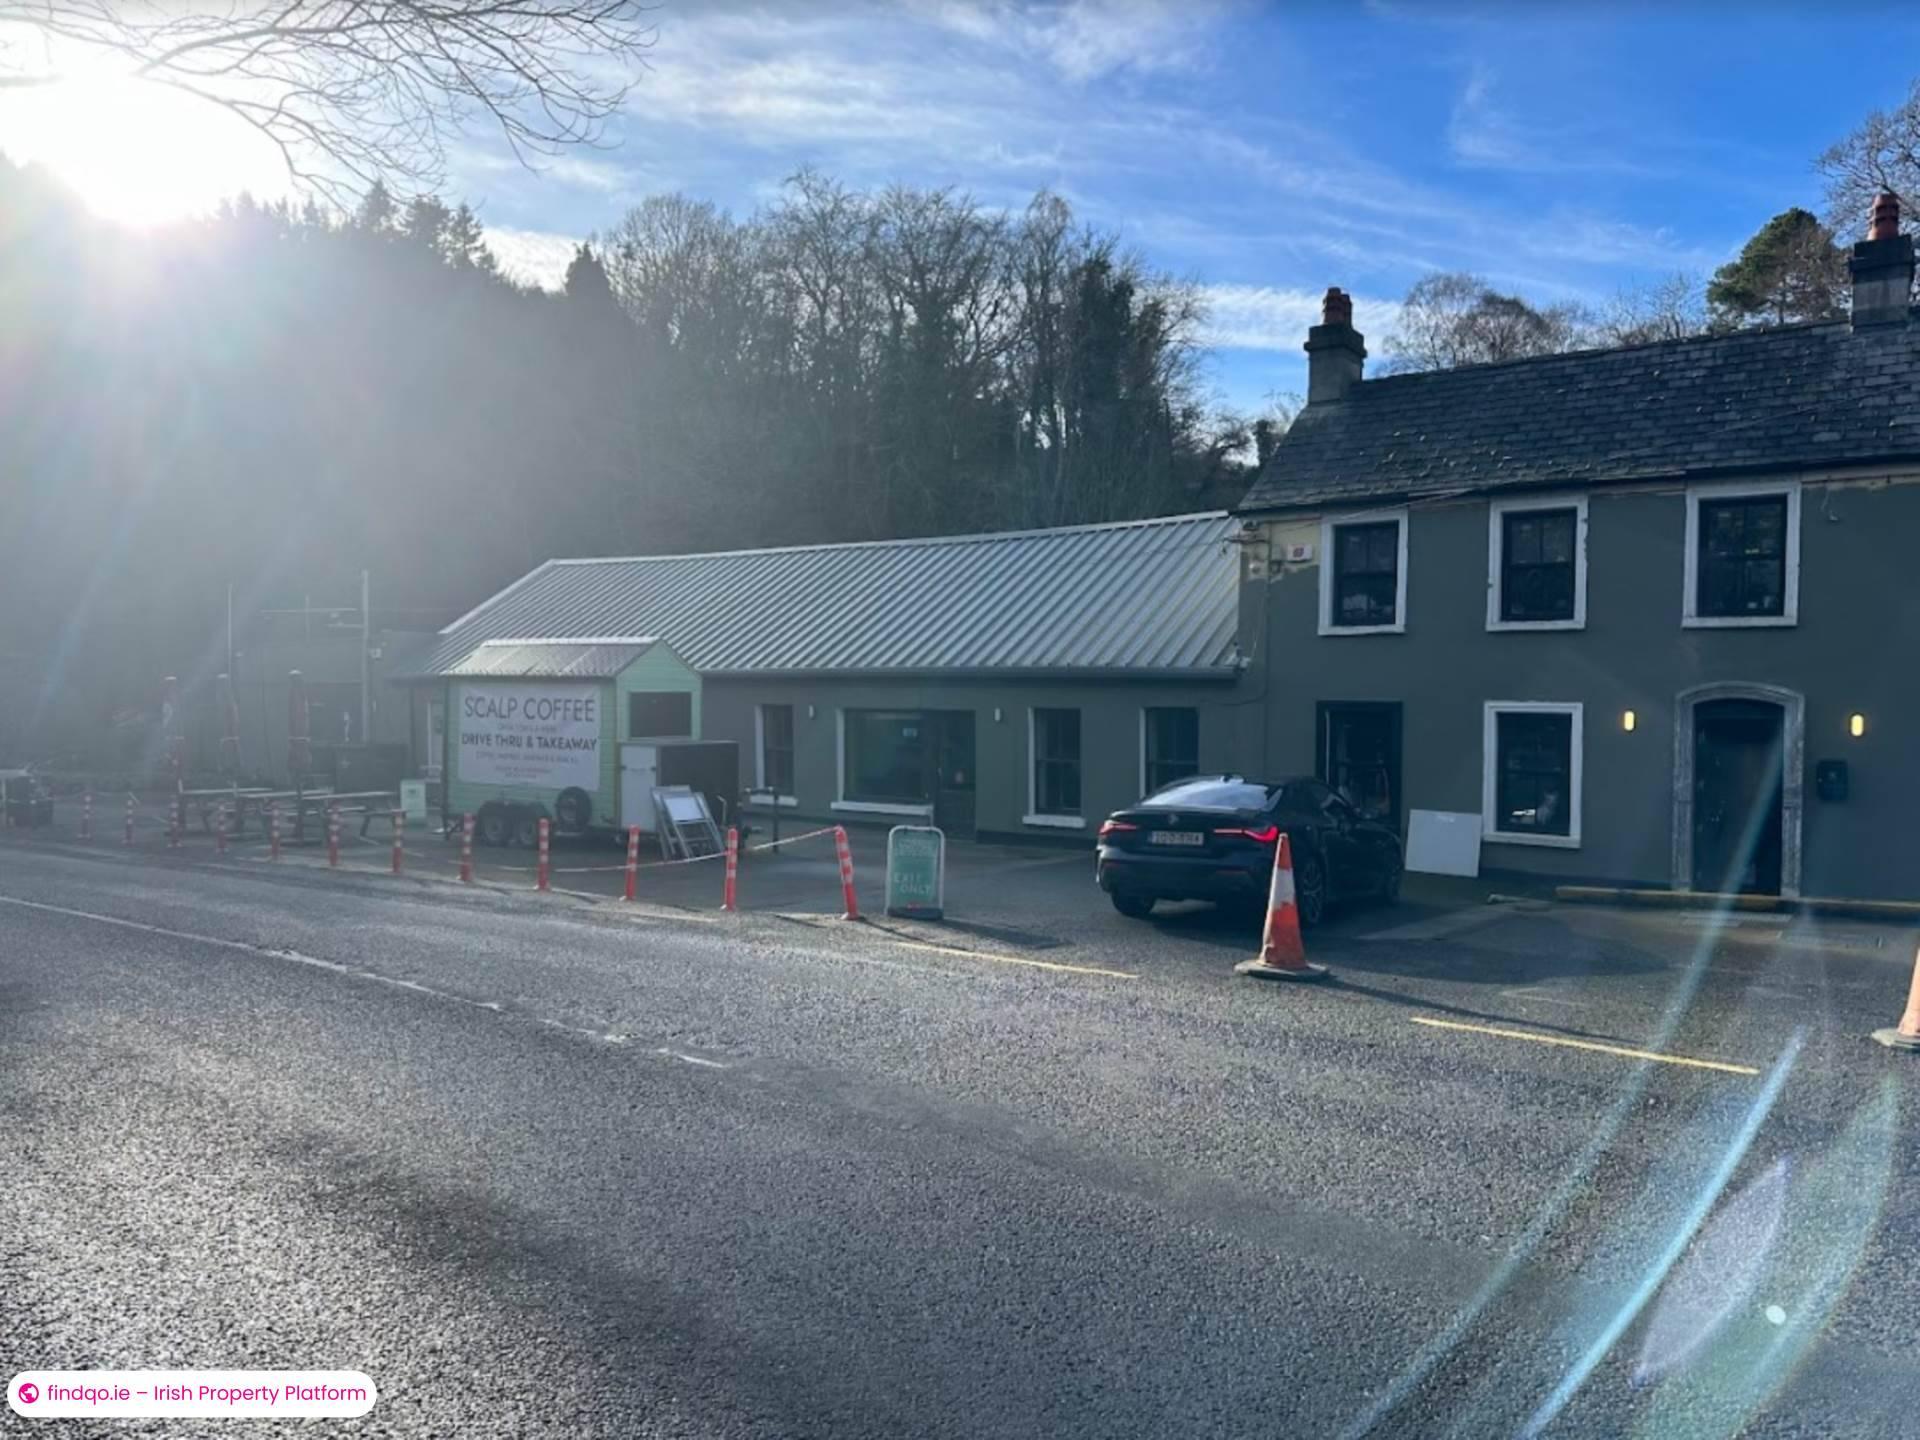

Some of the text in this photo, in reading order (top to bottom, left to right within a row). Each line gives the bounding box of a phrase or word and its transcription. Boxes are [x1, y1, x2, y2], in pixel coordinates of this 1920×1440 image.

[464, 696, 595, 722] SCALP COFFEE
[462, 733, 597, 752] DRIVE THRU & TAKEAWAY
